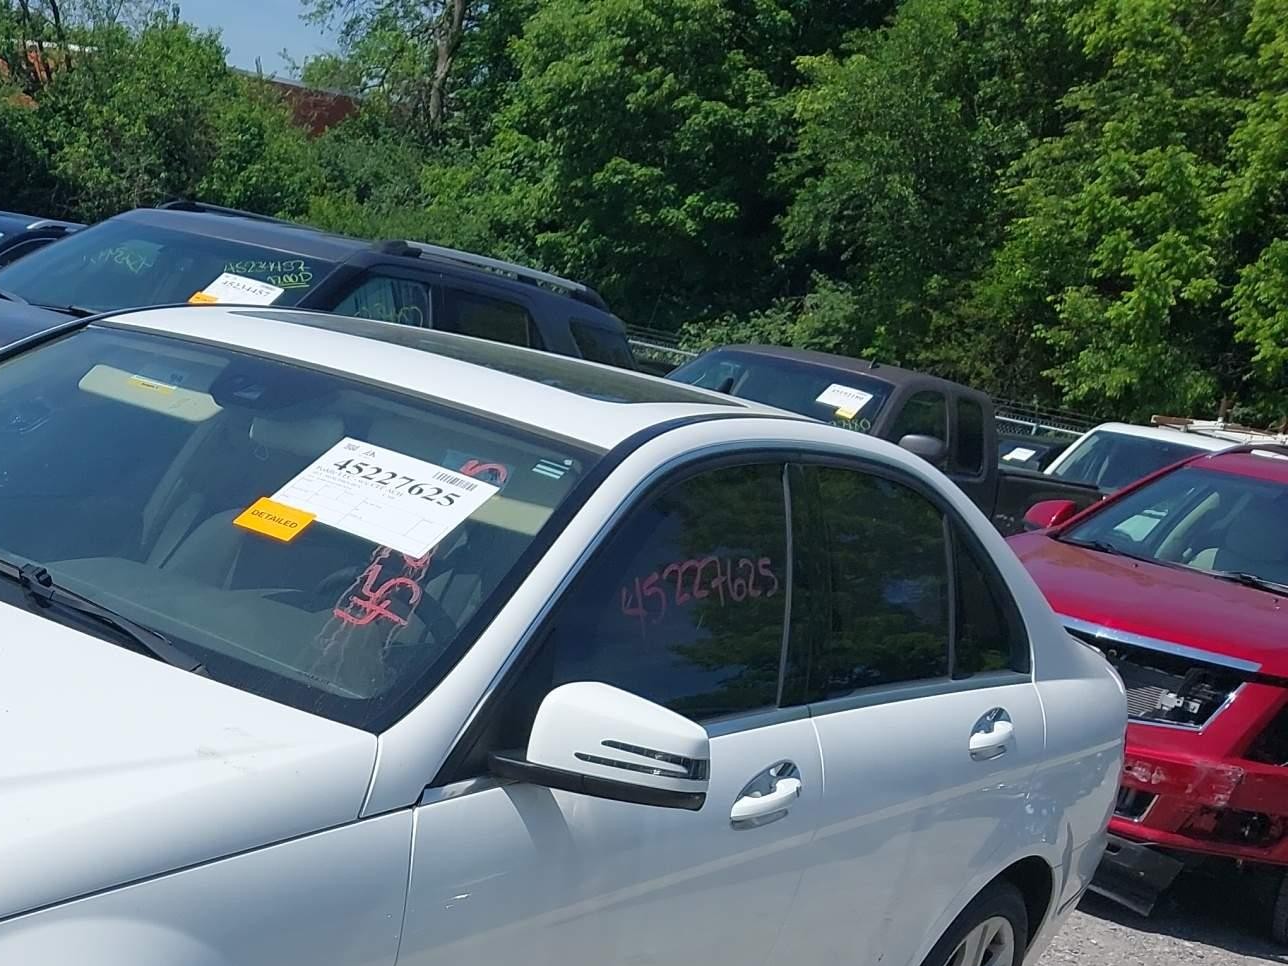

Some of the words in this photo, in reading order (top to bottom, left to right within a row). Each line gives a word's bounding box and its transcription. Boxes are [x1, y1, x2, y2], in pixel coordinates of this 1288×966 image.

[333, 458, 461, 508] 45227625
[251, 508, 299, 529] DETAILED
[621, 556, 779, 625] 45227625
